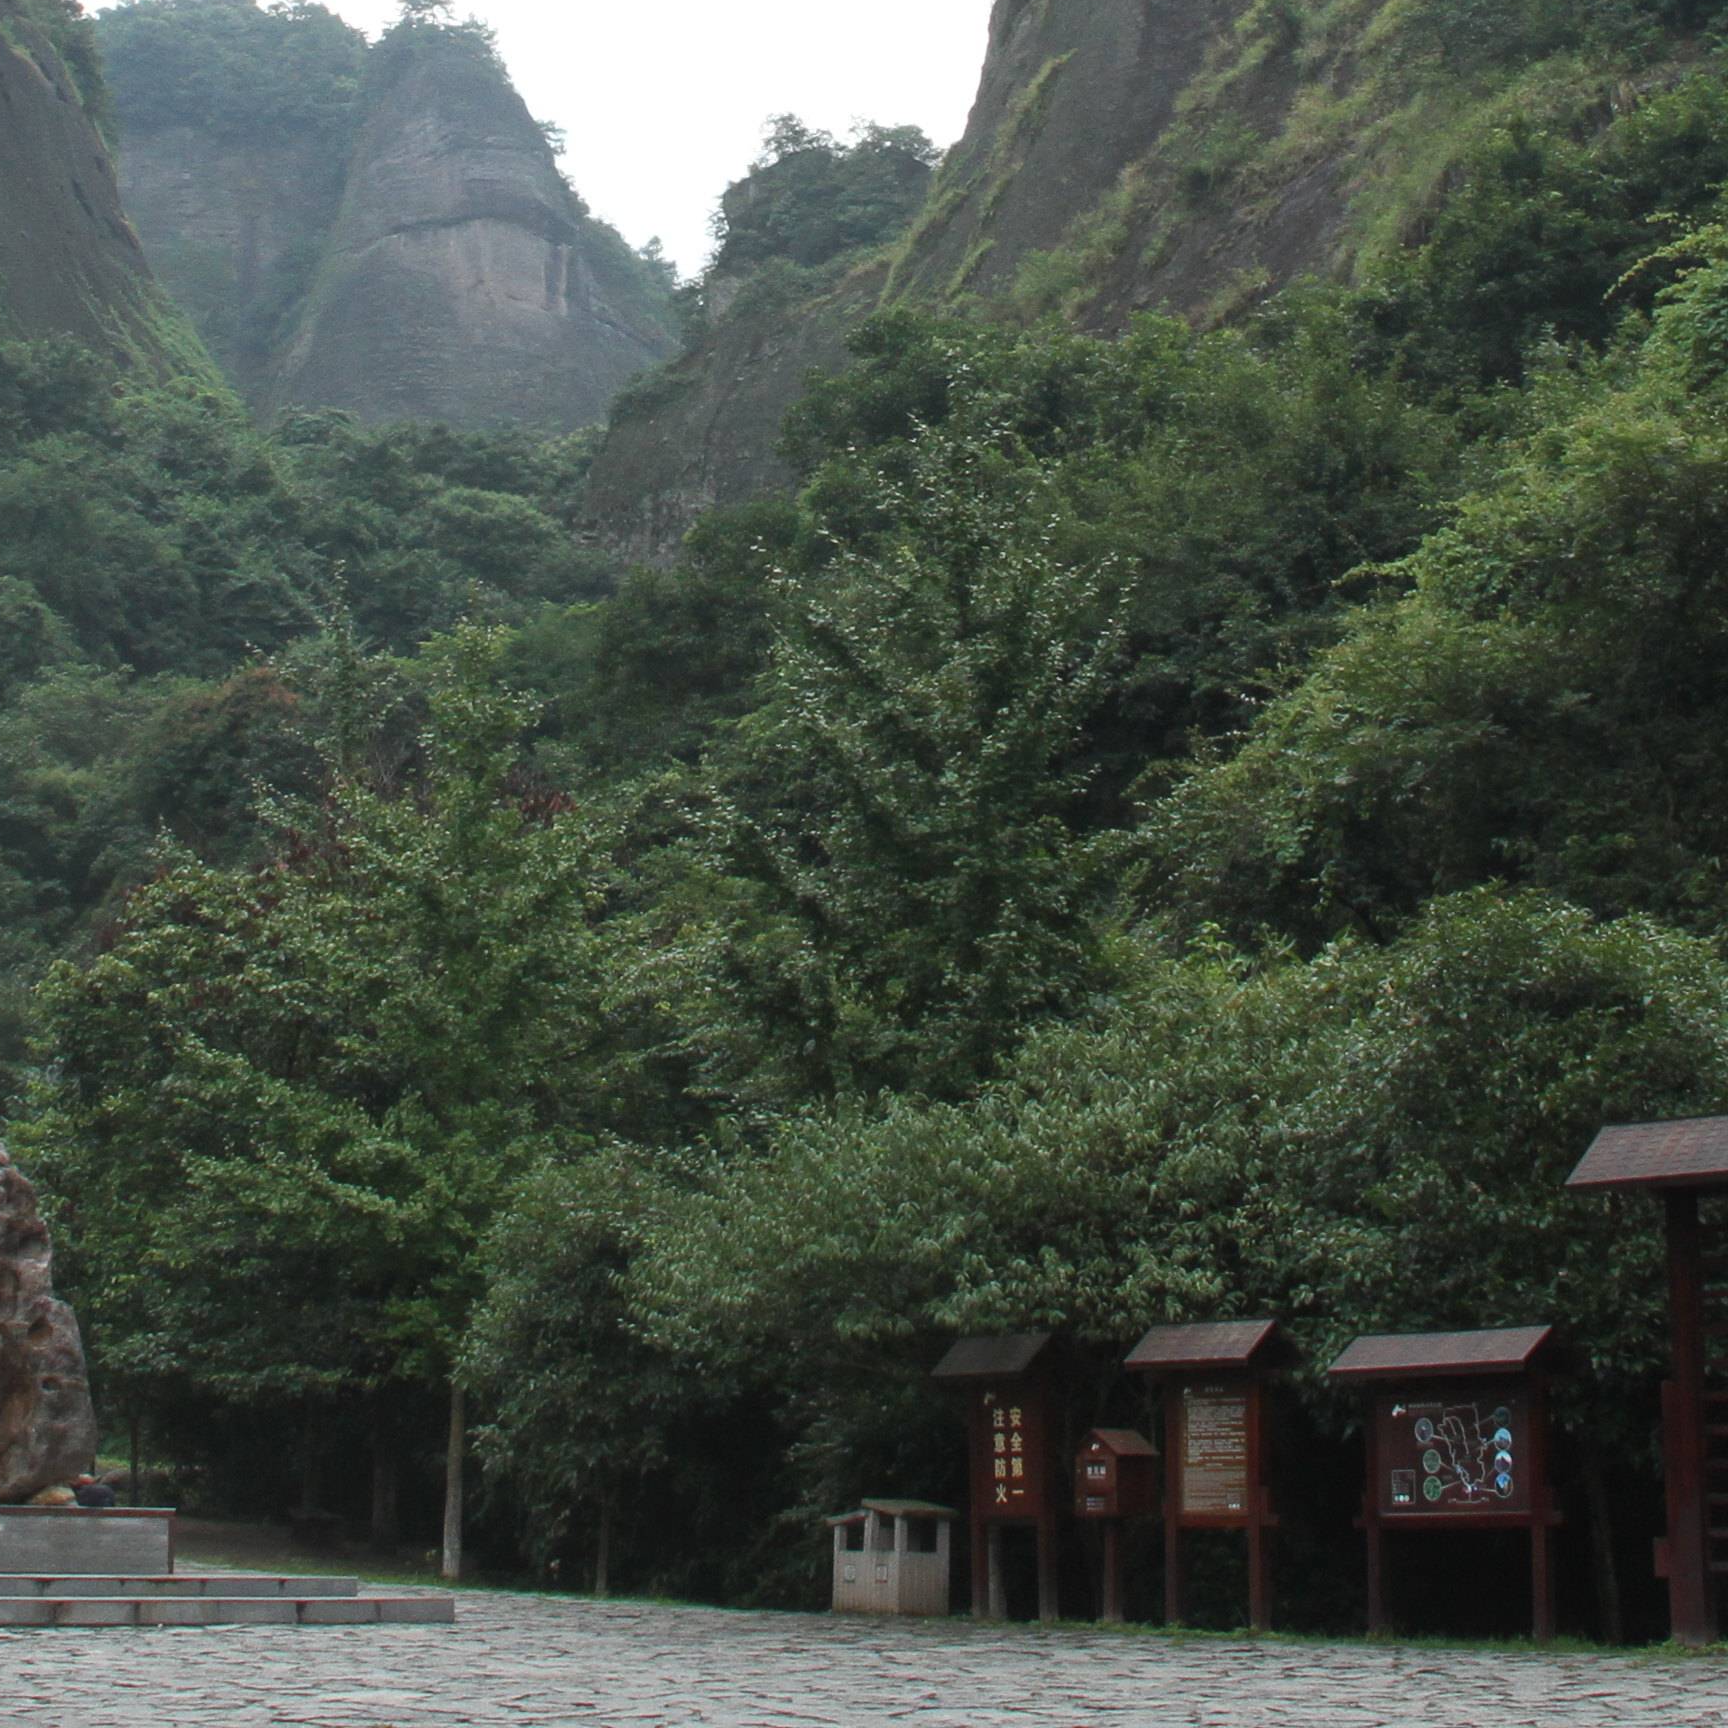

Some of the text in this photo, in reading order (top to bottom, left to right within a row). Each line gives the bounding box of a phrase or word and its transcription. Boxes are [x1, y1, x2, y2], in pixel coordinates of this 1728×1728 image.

[992, 1407, 1008, 1503] 注意防火
[1009, 1405, 1024, 1495] 安全第一
